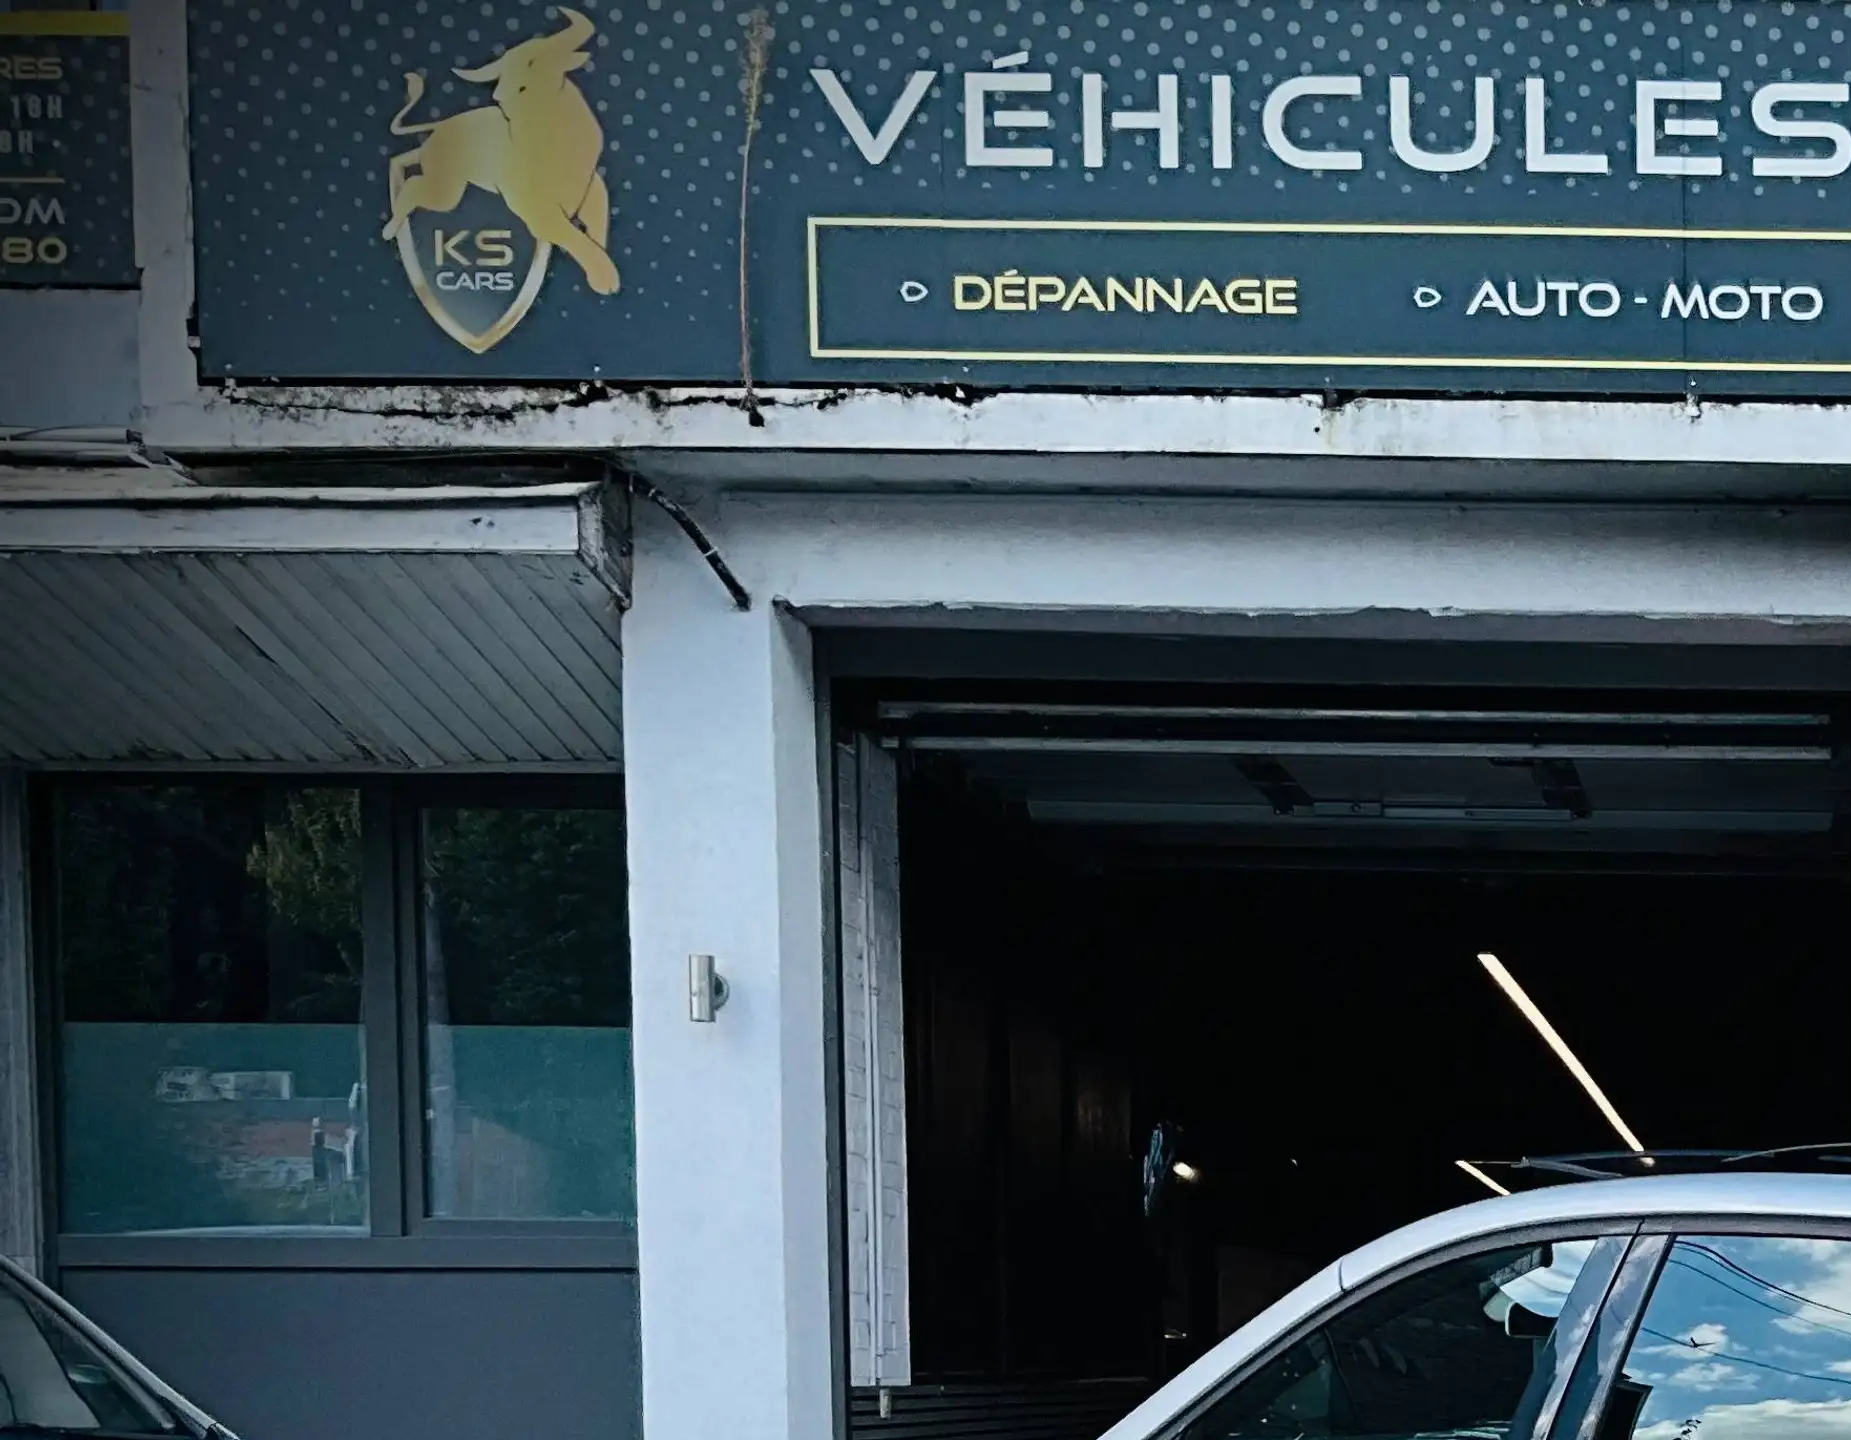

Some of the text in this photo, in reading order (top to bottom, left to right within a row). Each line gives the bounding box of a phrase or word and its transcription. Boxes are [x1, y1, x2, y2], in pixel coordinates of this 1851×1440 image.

[1, 235, 68, 265] 80
[433, 229, 515, 267] KS
[435, 270, 515, 292] CARS
[952, 267, 1299, 317] DÉPANNAGE
[1659, 284, 1825, 323] MOTO
